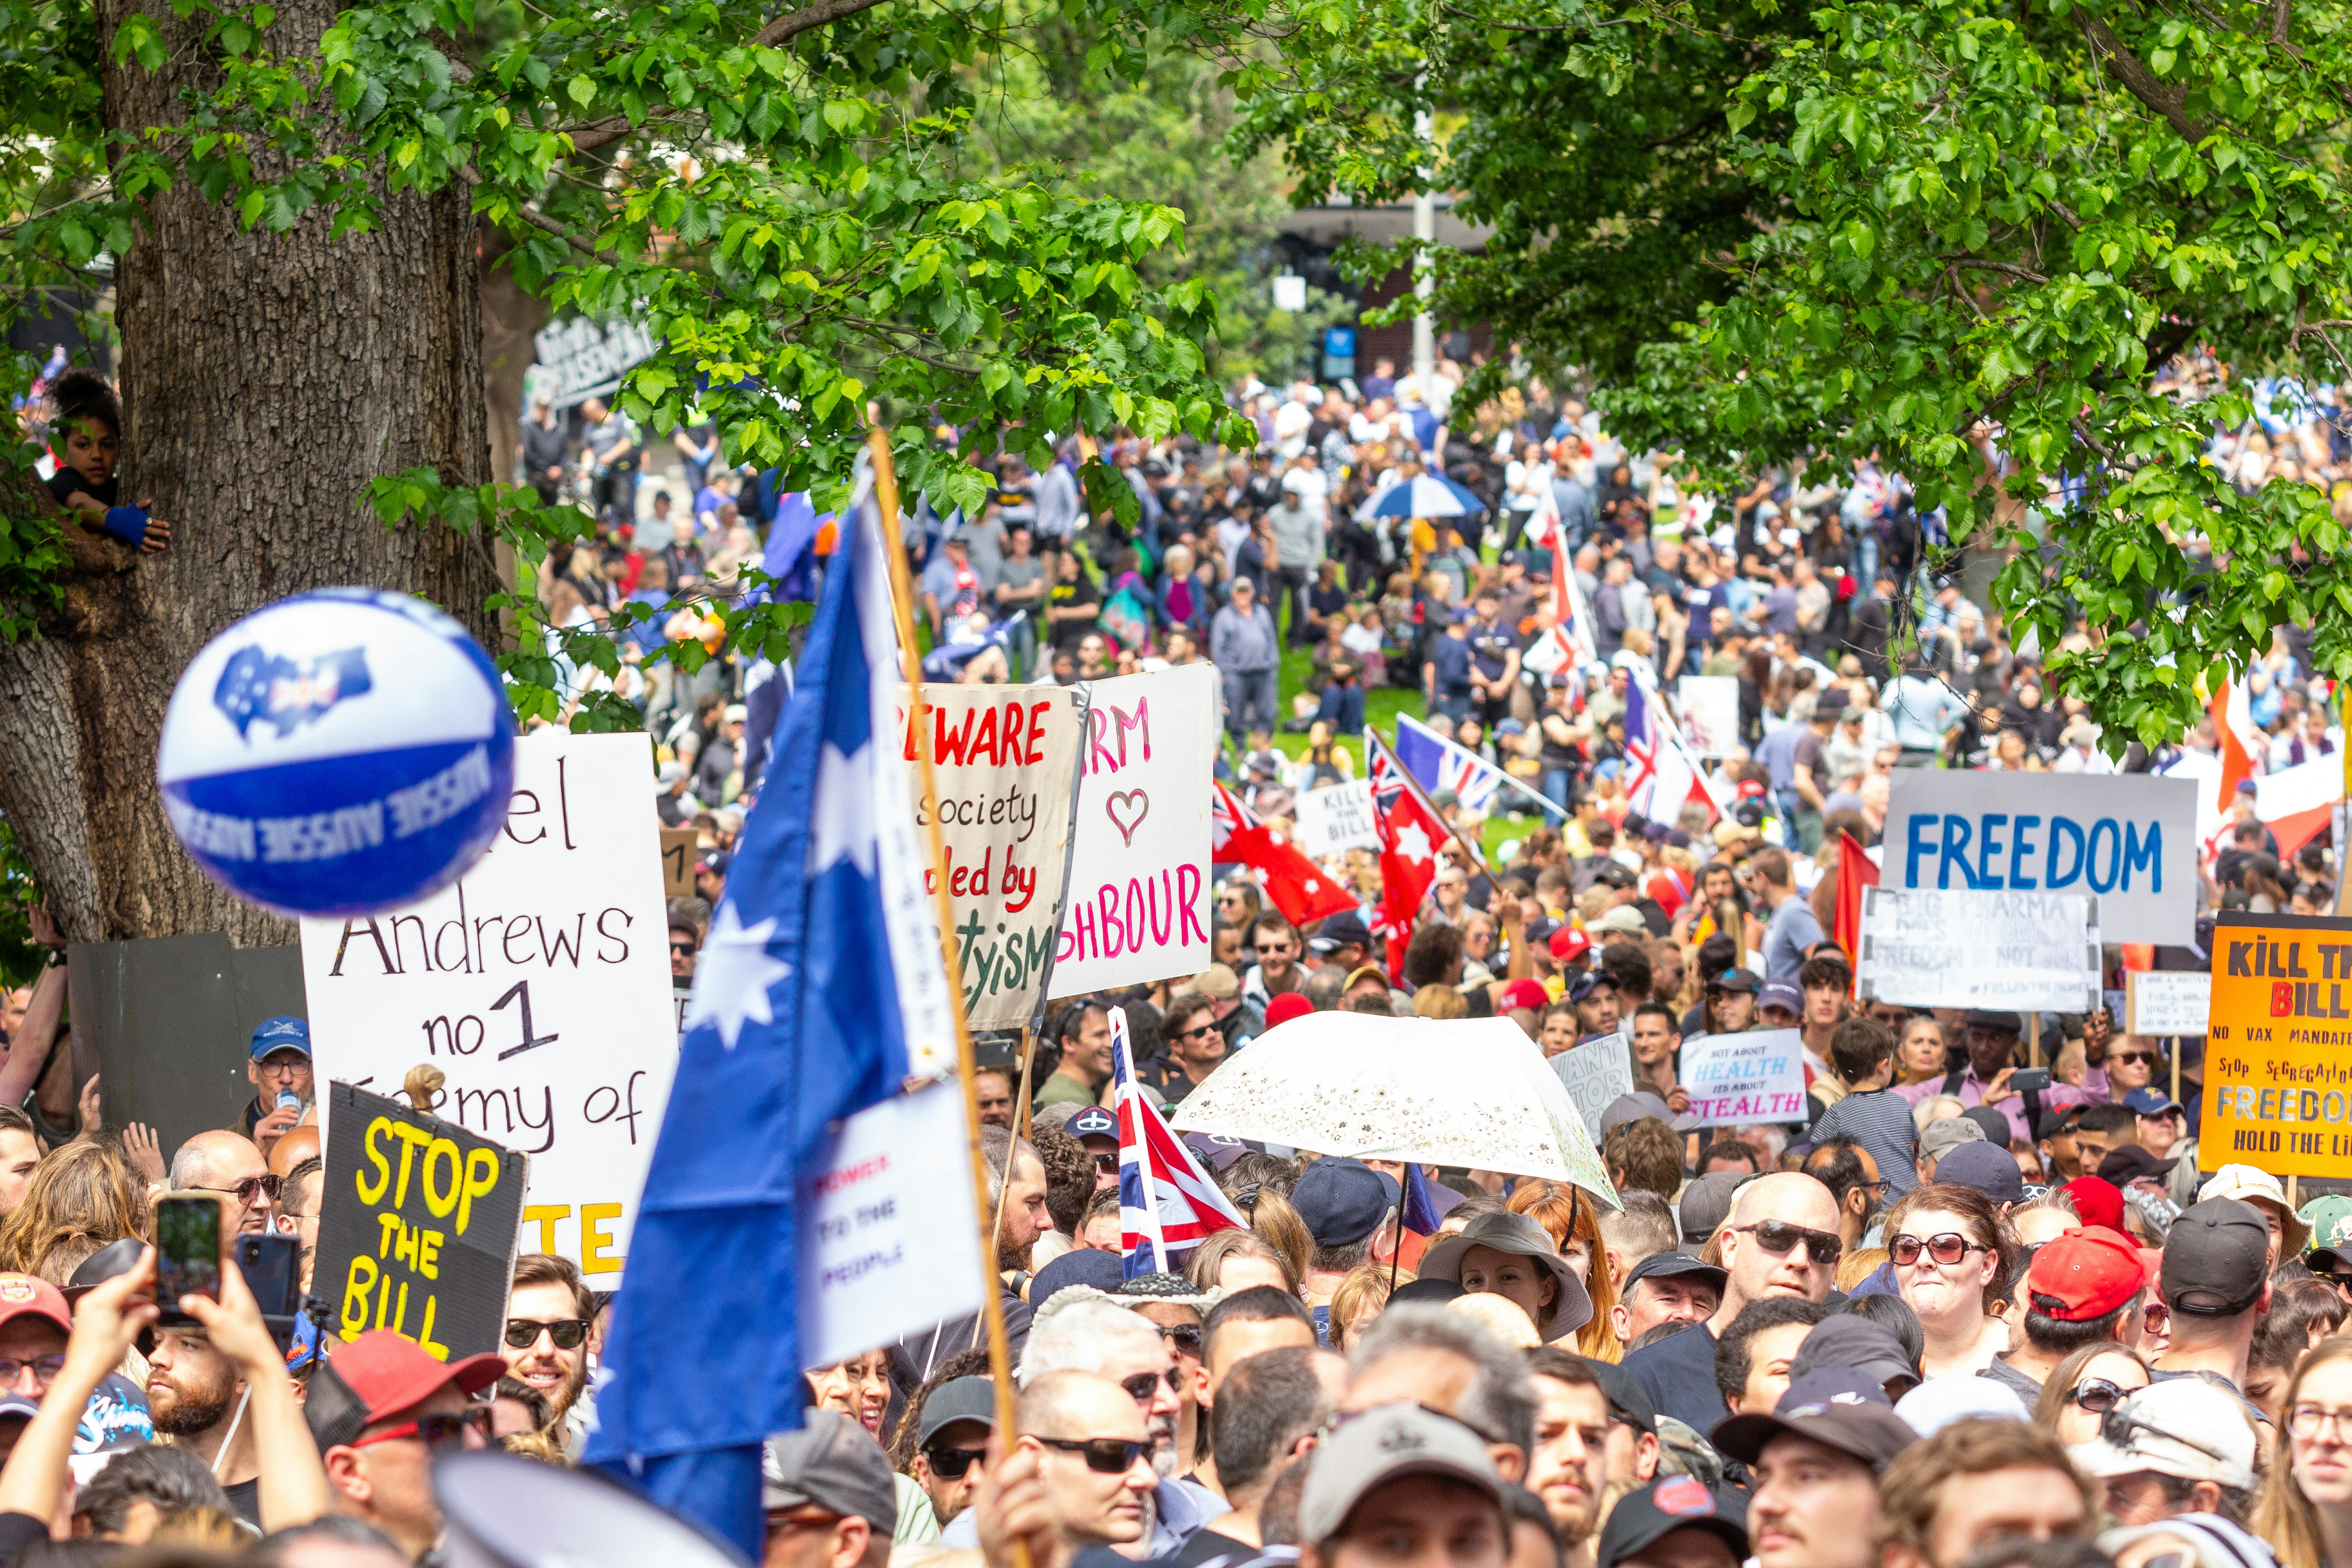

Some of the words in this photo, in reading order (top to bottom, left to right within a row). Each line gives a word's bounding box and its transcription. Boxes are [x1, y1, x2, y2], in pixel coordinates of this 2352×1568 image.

[1082, 696, 1151, 778] RM
[1323, 786, 1366, 810] KILL
[259, 800, 383, 863] AUSSIE
[1328, 818, 1372, 842] BILL
[1905, 813, 2163, 894] FREEDOM
[1002, 844, 1036, 913] by
[328, 879, 633, 977] Andrews
[2270, 981, 2350, 1019] BILL
[1710, 1048, 1731, 1059] NOT
[1732, 1045, 1768, 1057] ABOUT
[2212, 1025, 2229, 1040] NO
[2246, 1026, 2273, 1042] VAX
[2289, 1029, 2352, 1045] MANDATE
[1693, 1055, 1788, 1083] HEALTH
[1731, 1080, 1768, 1092] ABOUT
[2220, 1057, 2249, 1078] STOP
[583, 1070, 646, 1145] of
[1688, 1092, 1803, 1119] STEALTH
[2233, 1129, 2281, 1153] HOLD
[2289, 1131, 2325, 1155] THE
[356, 1115, 500, 1236] STOP
[377, 1212, 445, 1280] THE
[339, 1254, 449, 1362] BILL
